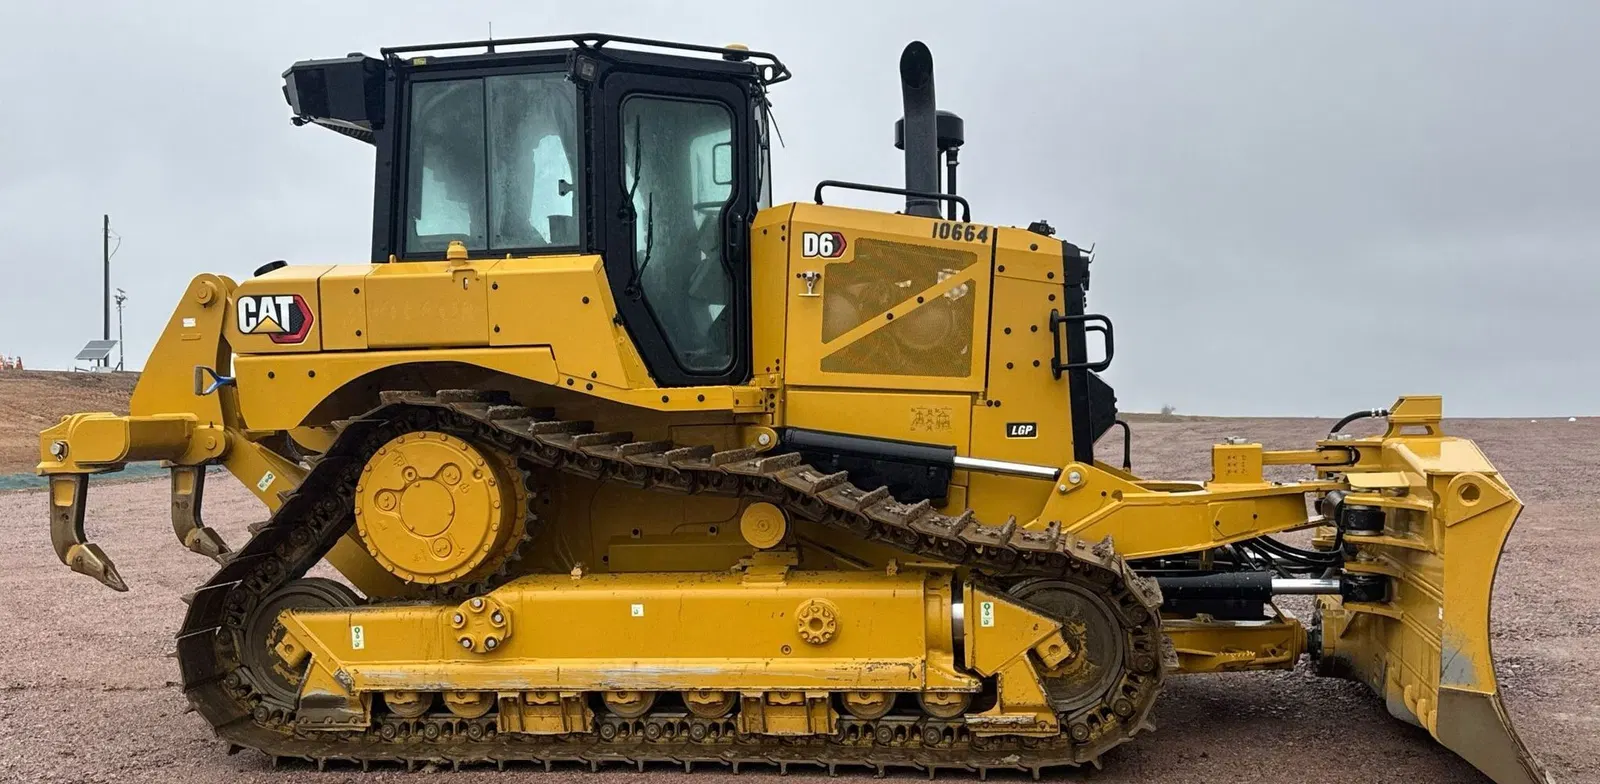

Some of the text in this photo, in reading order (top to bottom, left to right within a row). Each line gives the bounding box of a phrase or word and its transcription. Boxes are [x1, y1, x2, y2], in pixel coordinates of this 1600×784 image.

[932, 222, 989, 243] 10664
[804, 233, 834, 256] D6
[238, 295, 294, 333] CAT
[1011, 425, 1033, 436] LGP
